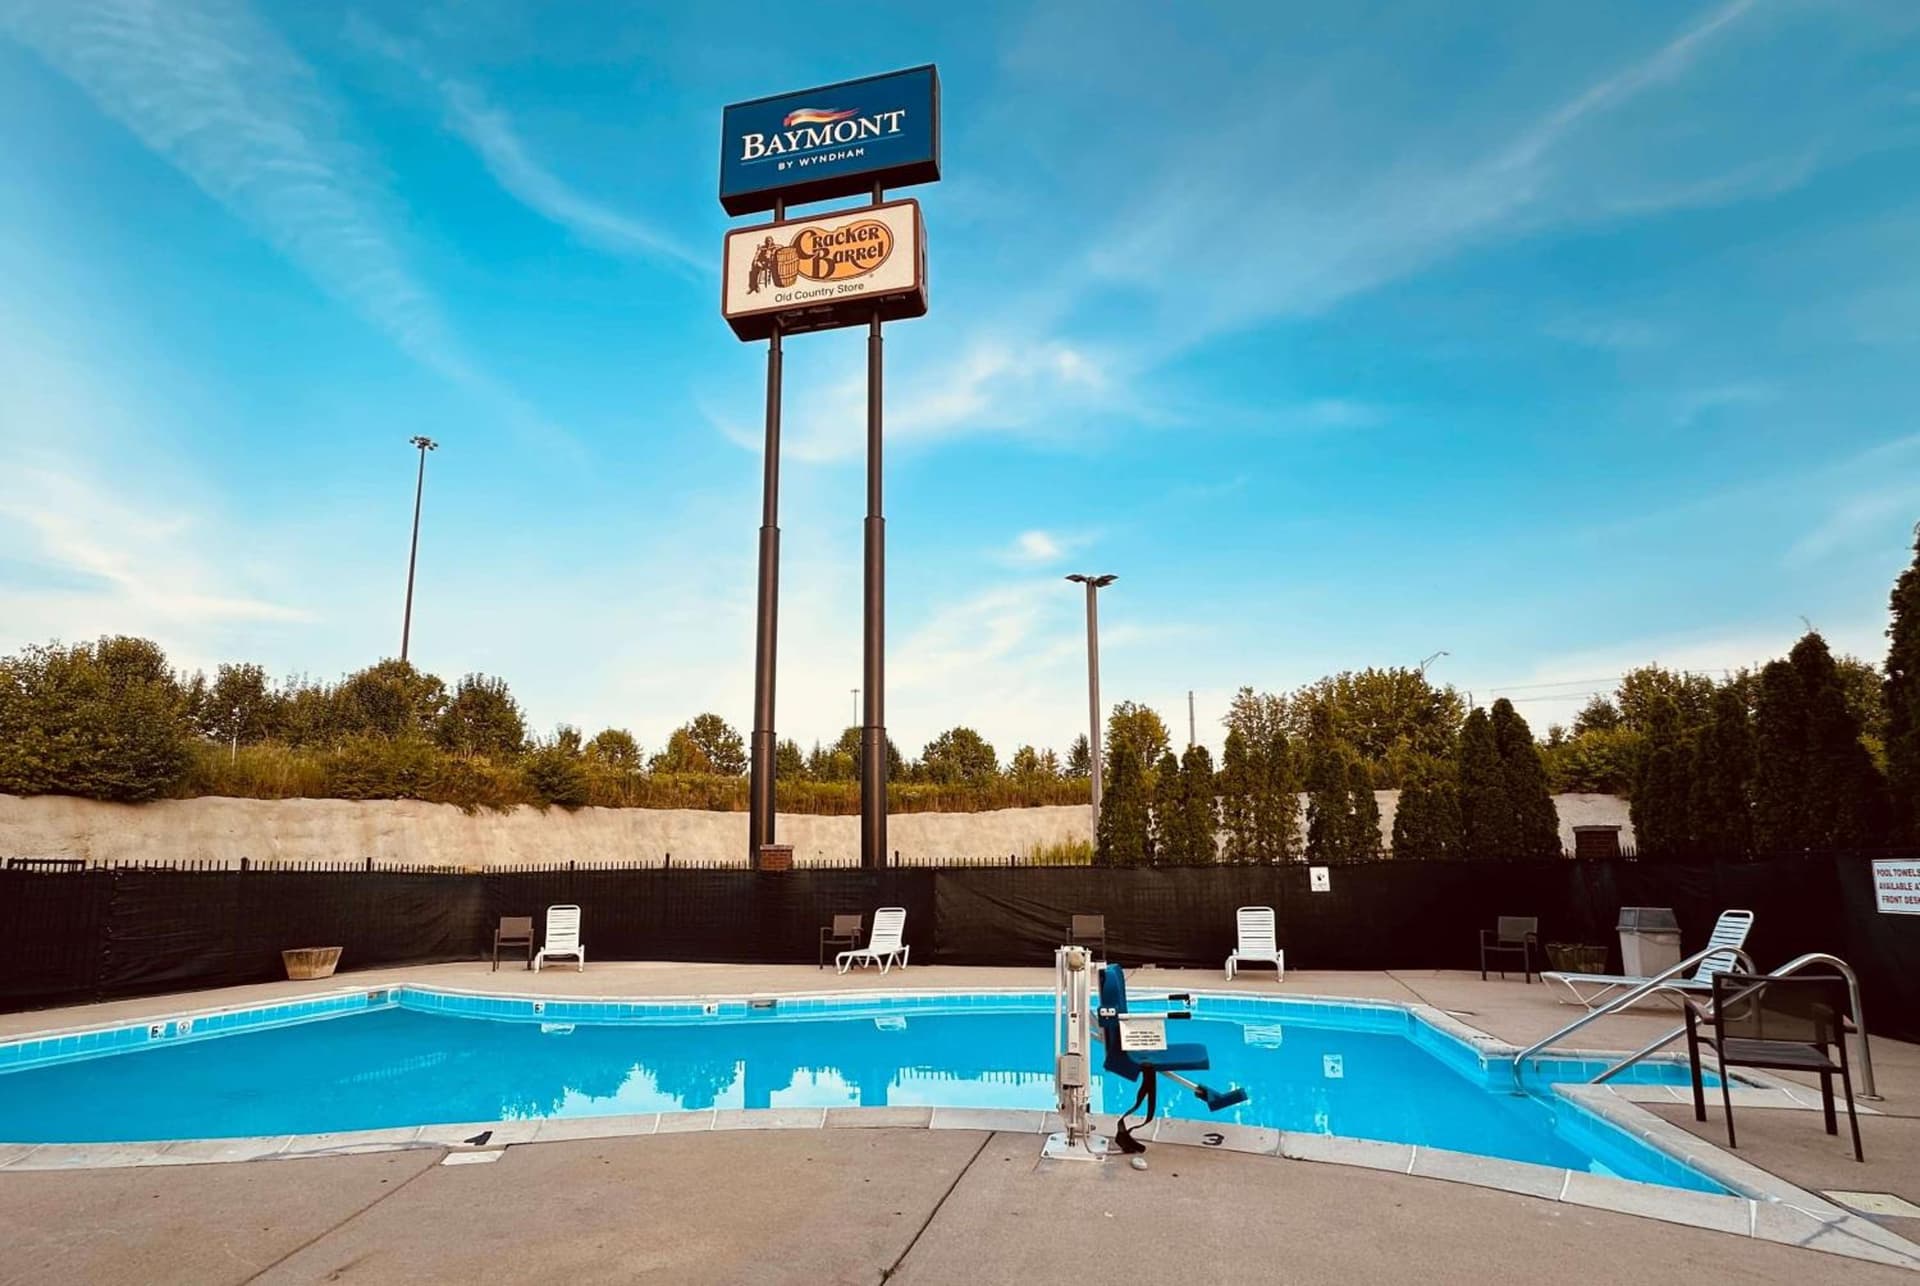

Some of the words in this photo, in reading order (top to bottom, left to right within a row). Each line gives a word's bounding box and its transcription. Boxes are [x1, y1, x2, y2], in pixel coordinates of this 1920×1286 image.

[741, 109, 905, 160] BAYMONT
[777, 161, 794, 171] BY
[799, 148, 864, 167] WYNDHAM
[792, 225, 880, 260] Cracker
[811, 240, 884, 279] Barrel
[774, 292, 792, 303] Old
[794, 286, 834, 301] Country
[837, 282, 864, 294] Store
[1201, 1133, 1225, 1146] 3
